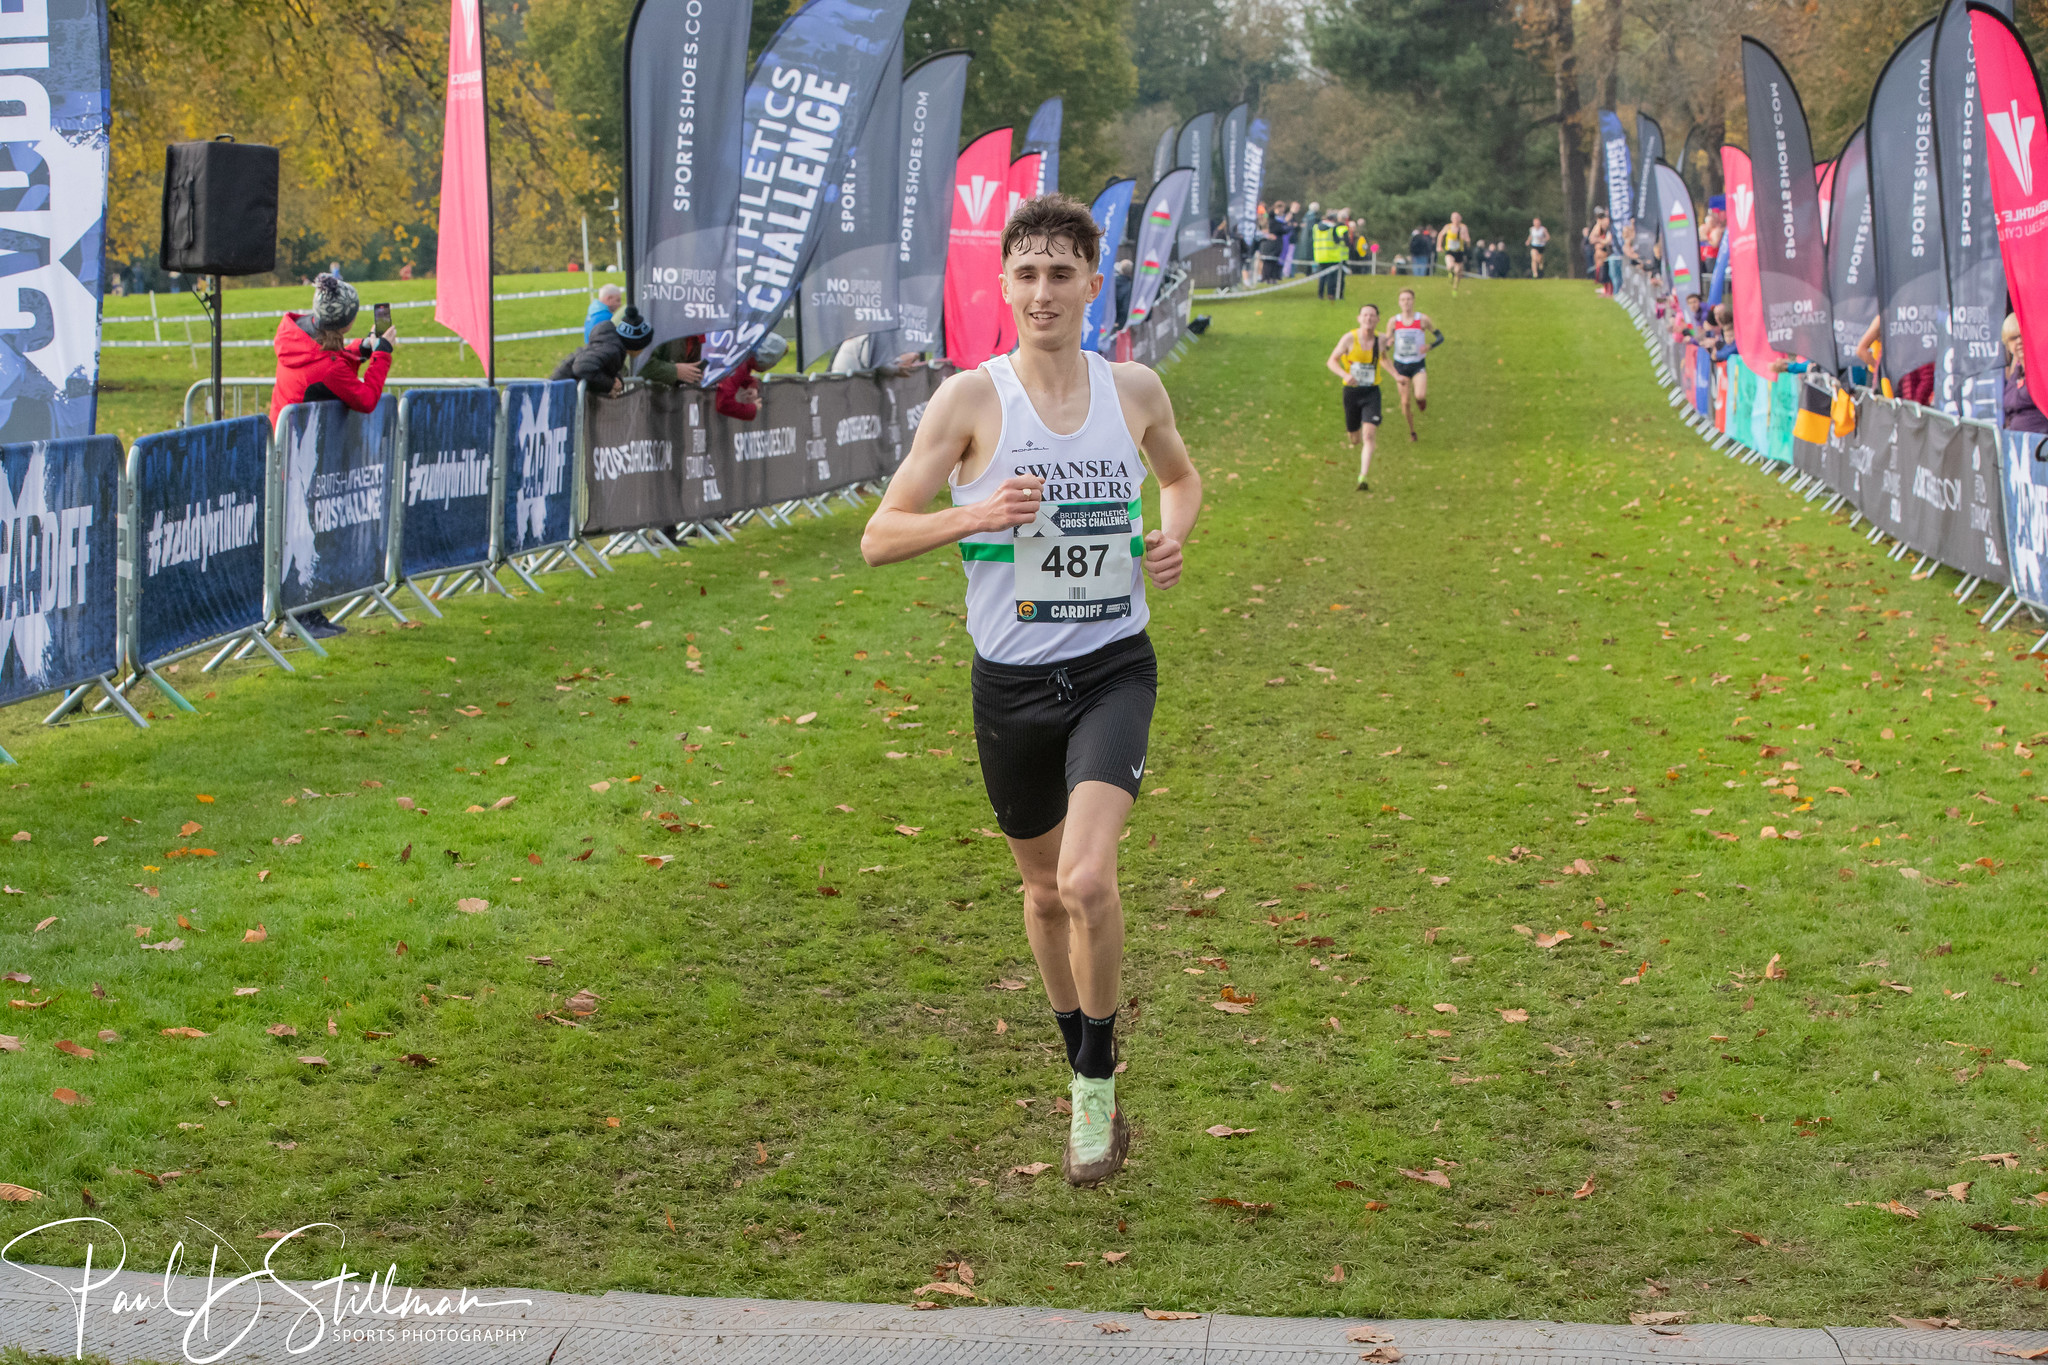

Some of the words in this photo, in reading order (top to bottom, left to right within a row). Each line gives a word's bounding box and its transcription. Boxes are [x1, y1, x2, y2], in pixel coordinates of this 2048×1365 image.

[1912, 59, 1931, 257] SPORTSSHOES.COM
[900, 91, 929, 262] SPORTSSHOES.COM
[748, 74, 850, 312] CHALLENGE
[652, 266, 679, 284] NO
[681, 267, 717, 286] FUN
[827, 279, 849, 292] NO
[812, 293, 881, 308] STANDING
[684, 302, 730, 319] STILL
[855, 308, 894, 321] STILL
[1897, 306, 1918, 321] NO
[1014, 460, 1129, 481] SWANSEA
[1060, 511, 1091, 520] BRITISH
[1091, 509, 1129, 518] ATHLETICS
[1060, 518, 1087, 528] CROSS
[1088, 516, 1129, 527] CHALLENGE
[1041, 544, 1109, 578] 487
[1050, 604, 1103, 618] CARDIFF
